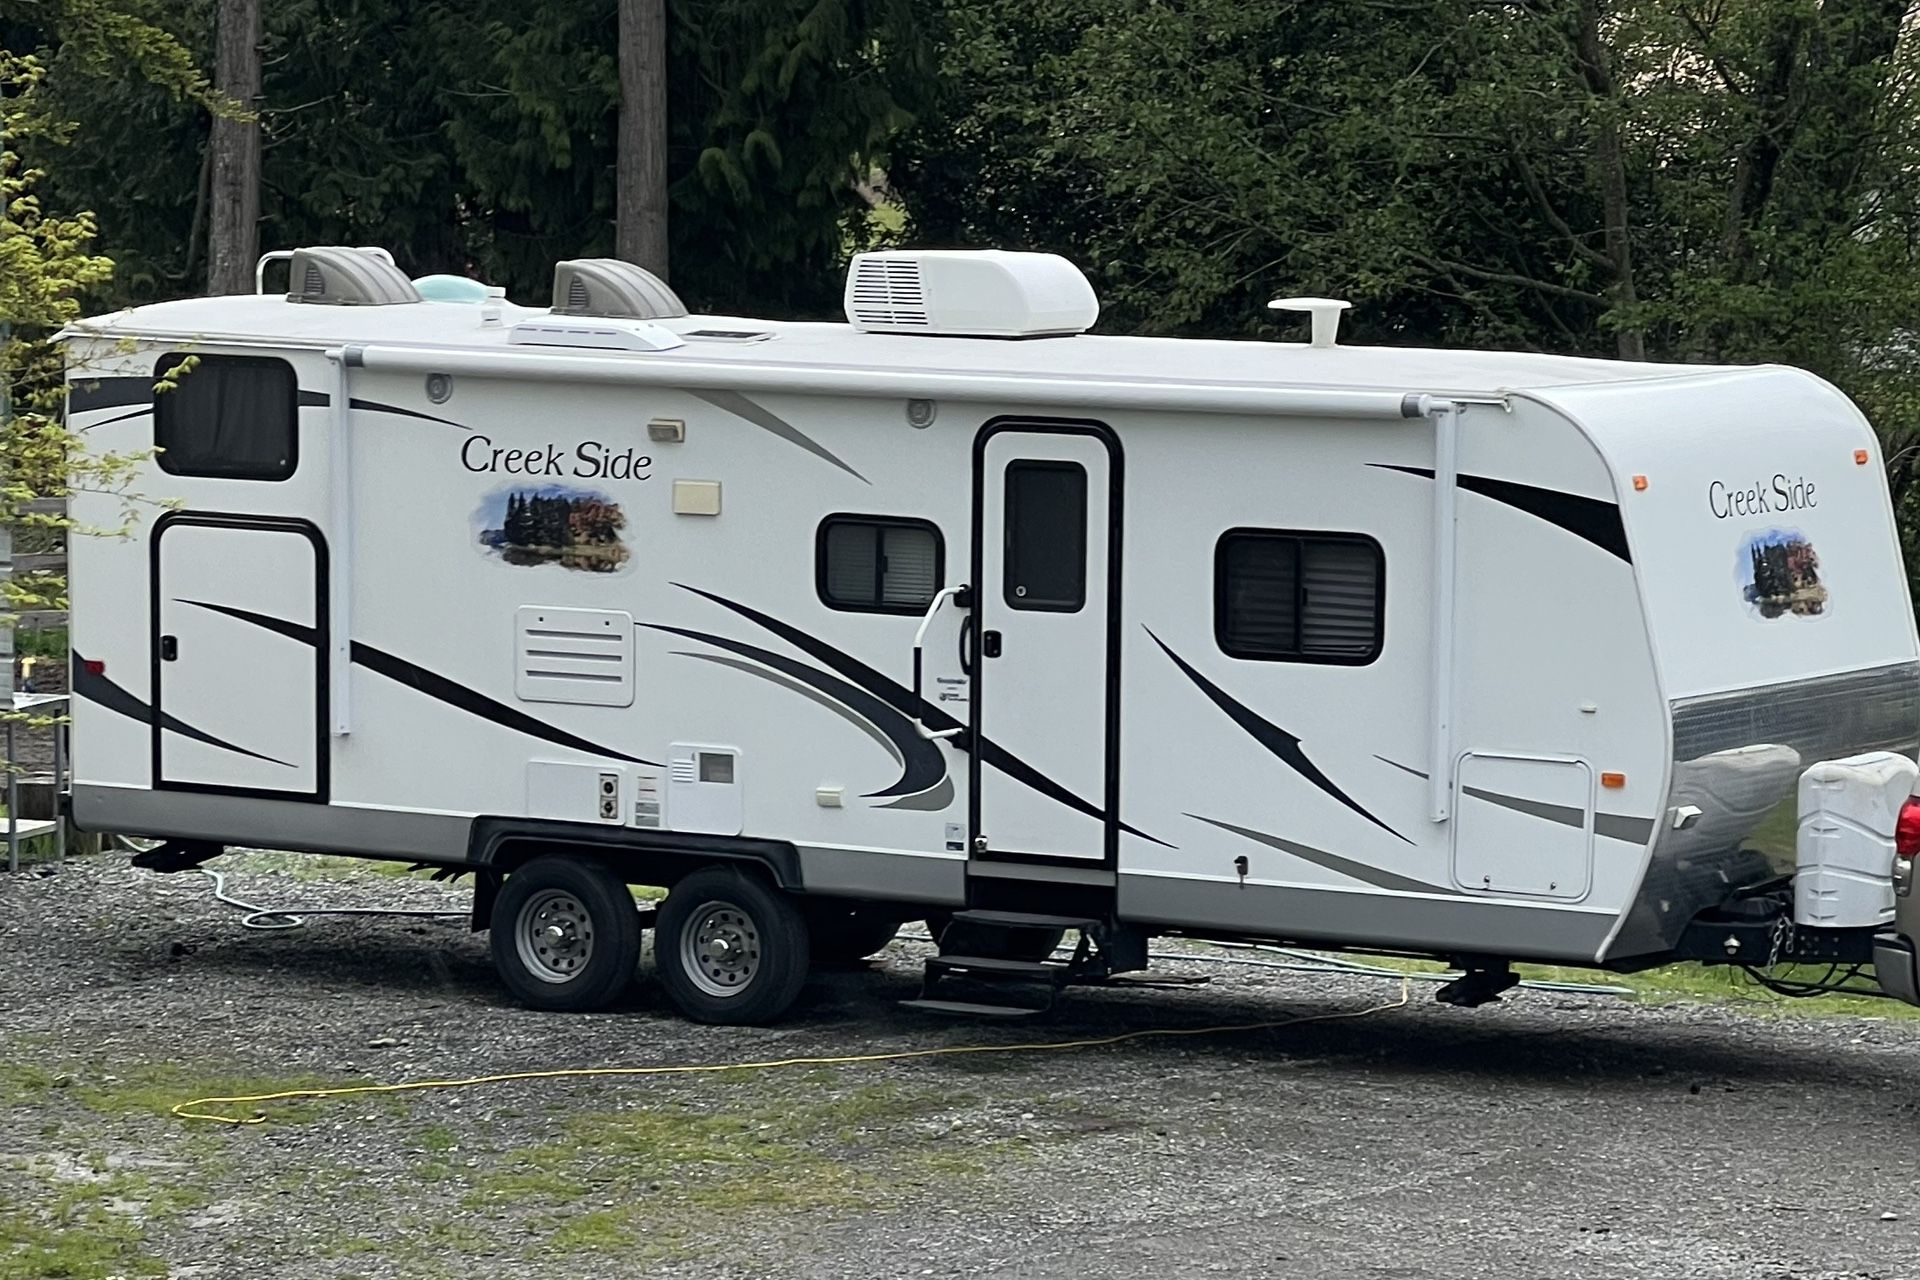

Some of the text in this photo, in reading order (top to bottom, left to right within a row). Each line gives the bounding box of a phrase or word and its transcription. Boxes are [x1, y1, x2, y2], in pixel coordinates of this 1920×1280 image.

[461, 435, 652, 481] Creek Side
[1709, 473, 1818, 519] Creek Side
